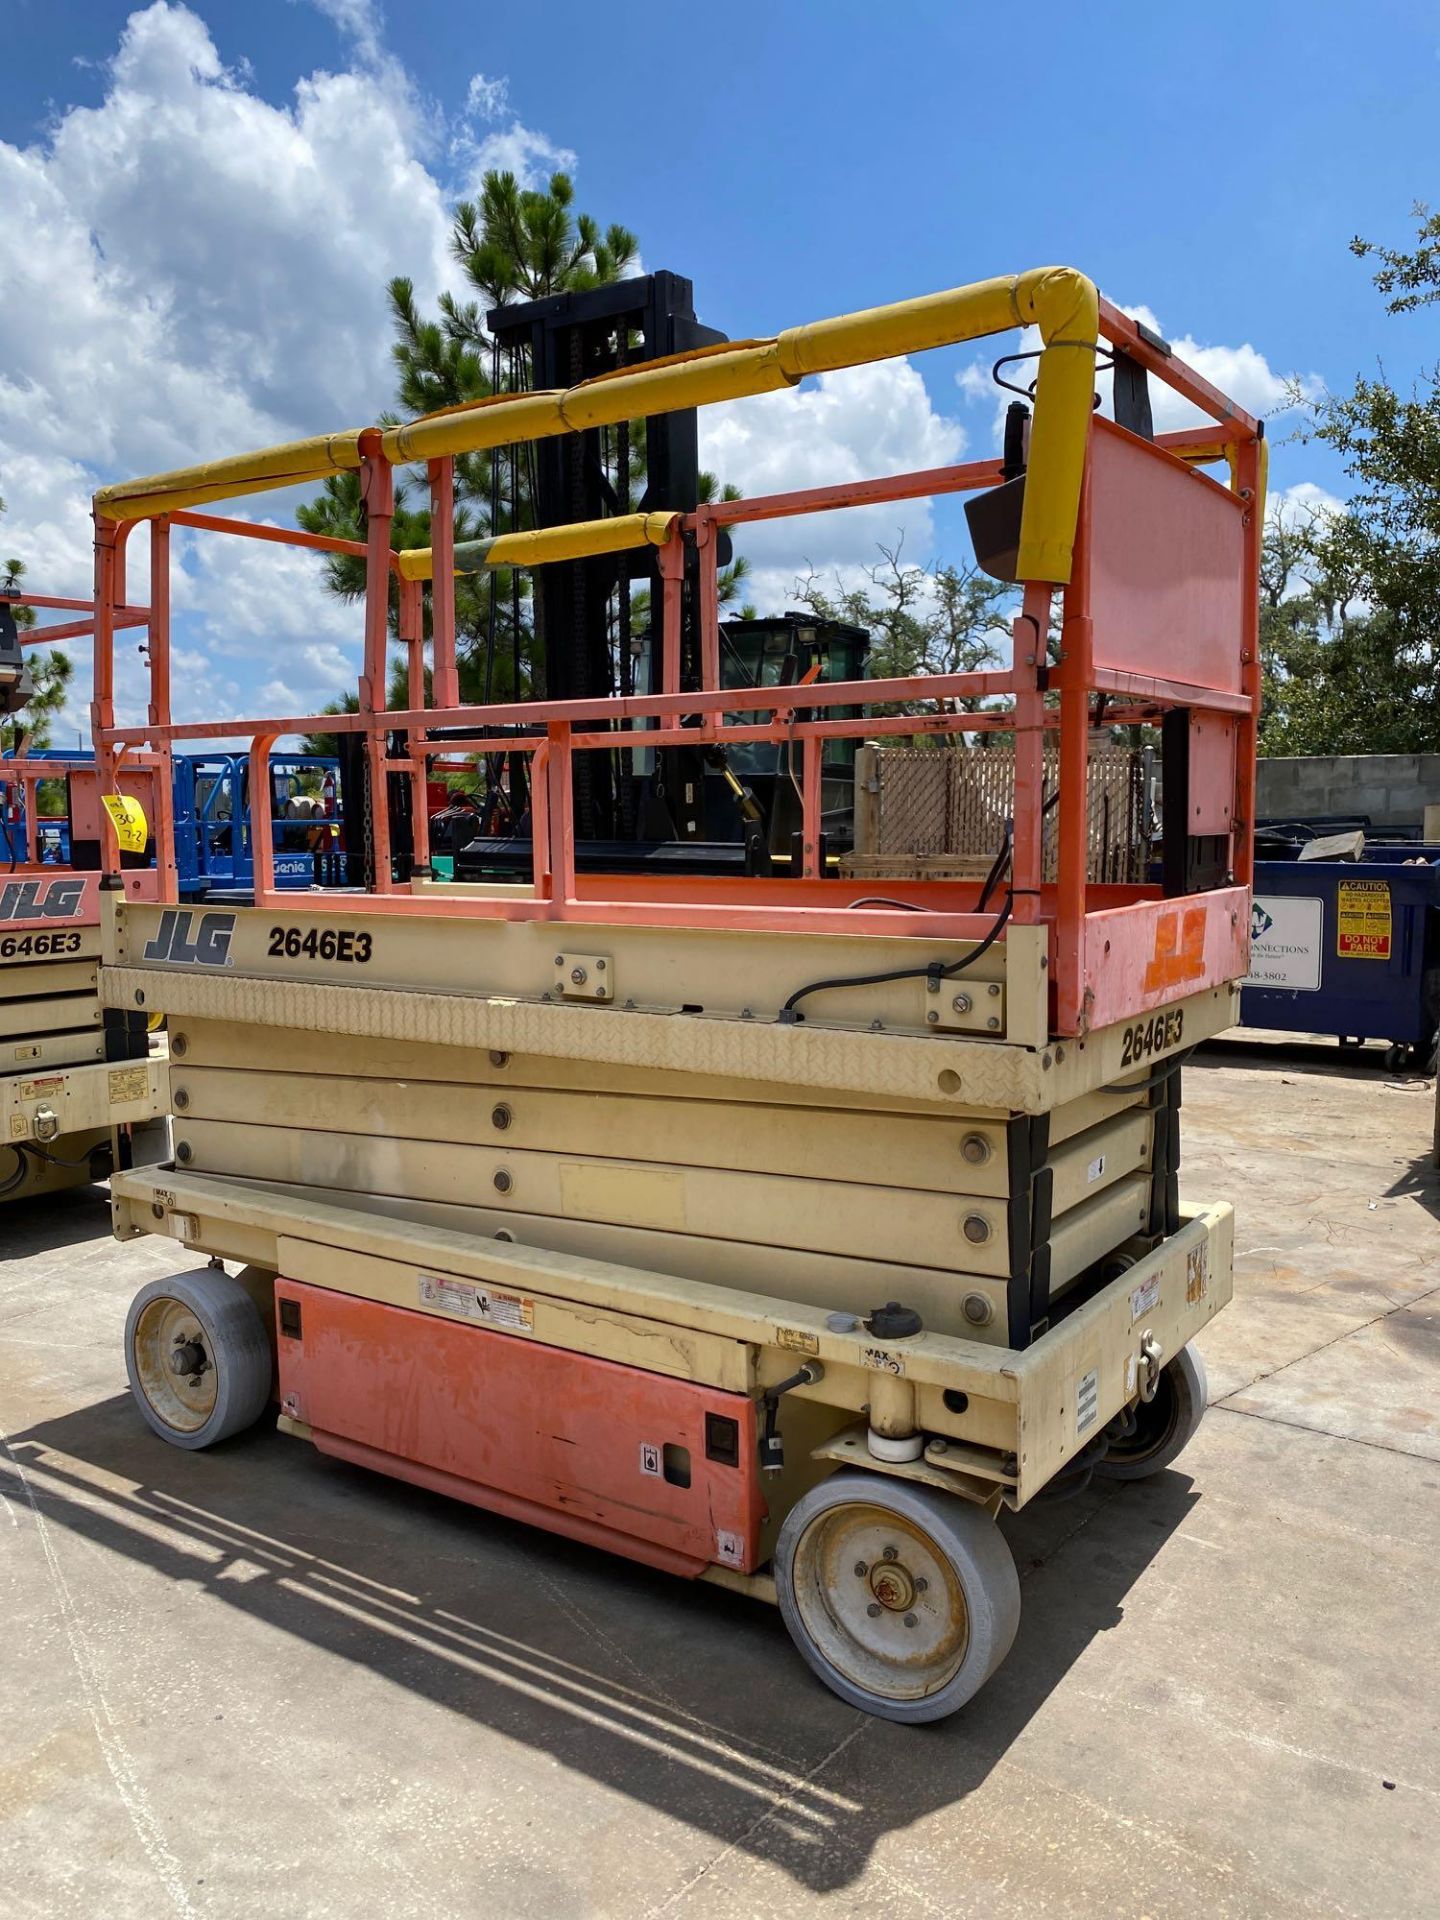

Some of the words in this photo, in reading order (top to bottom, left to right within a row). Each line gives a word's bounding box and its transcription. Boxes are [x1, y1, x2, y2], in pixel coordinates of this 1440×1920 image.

[115, 813, 136, 826] 30
[272, 860, 306, 874] Genie
[1349, 882, 1390, 891] CAUTION
[143, 910, 237, 967] JLG
[267, 926, 373, 963] 2646E3
[1345, 934, 1360, 943] DO
[1362, 935, 1385, 944] NOT
[1350, 943, 1378, 953] PARK
[1120, 1009, 1183, 1067] 2646E3
